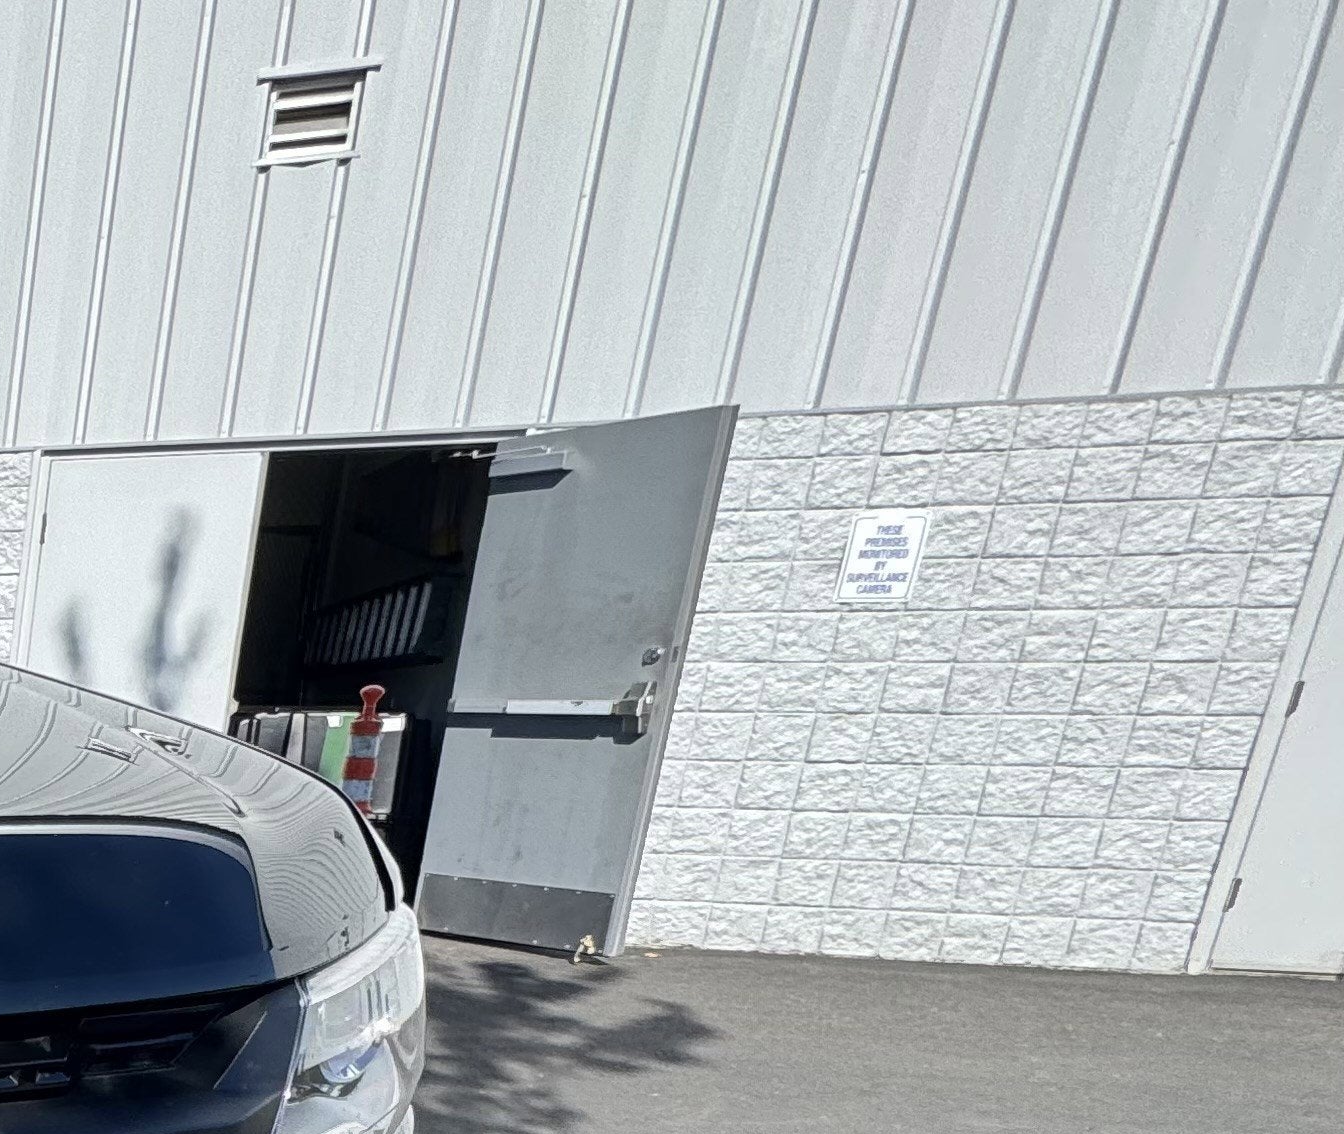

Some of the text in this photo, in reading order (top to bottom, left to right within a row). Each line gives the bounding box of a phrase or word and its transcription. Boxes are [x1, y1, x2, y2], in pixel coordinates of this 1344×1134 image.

[877, 525, 904, 535] THESE
[865, 537, 909, 547] PREMISES
[858, 549, 909, 559] MONITORED
[874, 561, 887, 571] BY
[846, 572, 909, 582] SURVEILLANCE
[856, 584, 892, 594] CAMERA
